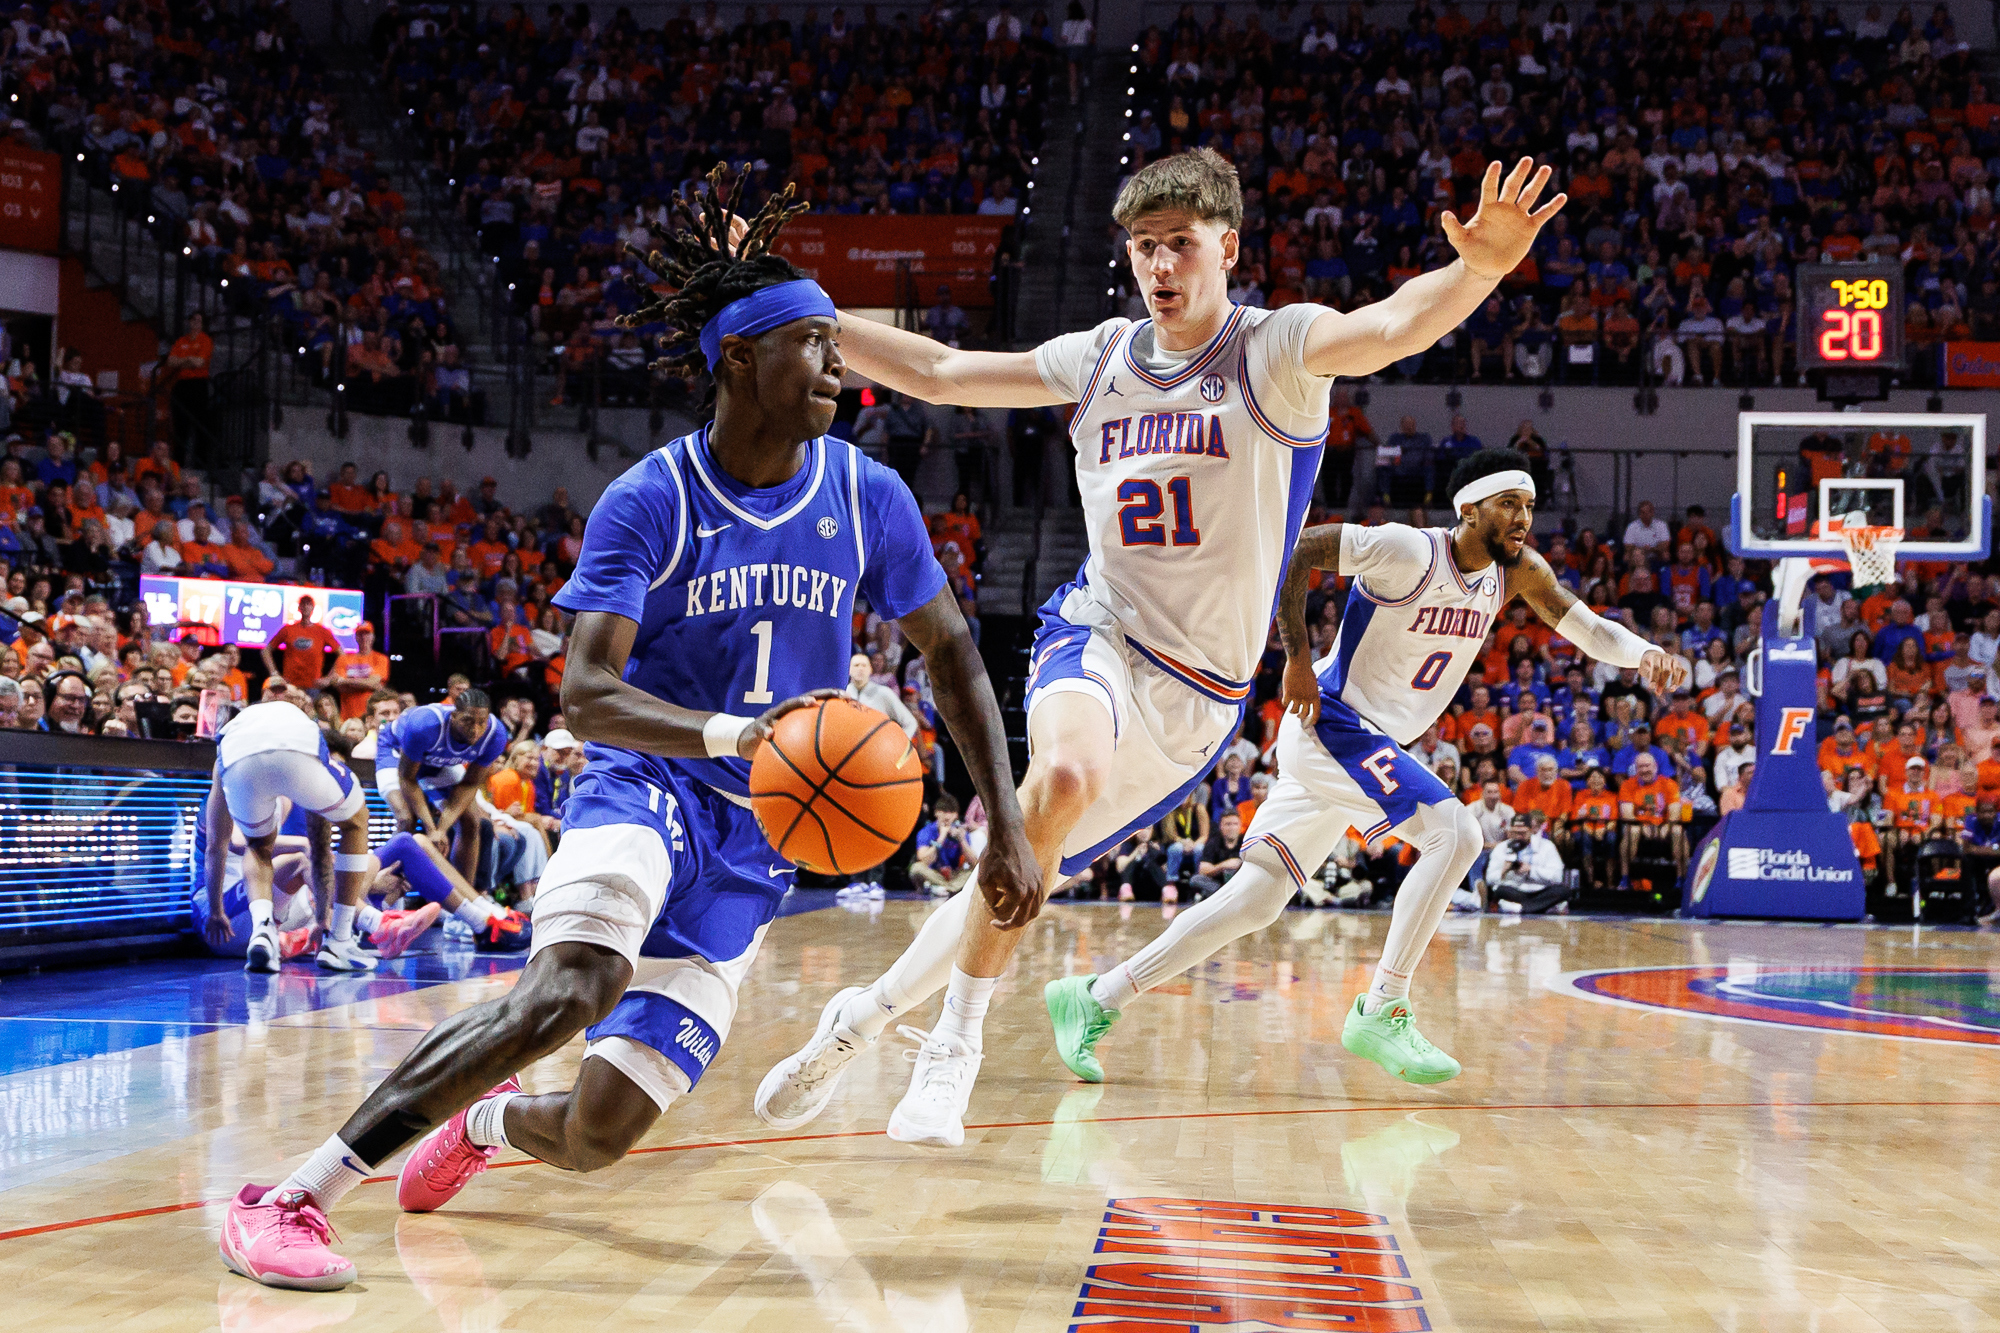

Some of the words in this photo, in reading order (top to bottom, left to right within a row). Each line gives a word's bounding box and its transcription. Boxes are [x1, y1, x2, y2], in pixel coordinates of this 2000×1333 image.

[1831, 279, 1888, 310] 7:50
[1820, 310, 1882, 361] 20
[1201, 374, 1224, 401] SEC
[1099, 412, 1230, 465] FLORIDA
[818, 517, 838, 539] SEC
[1117, 476, 1201, 547] 21
[185, 595, 220, 624] 17
[686, 563, 848, 619] KENTUCKY
[743, 620, 774, 705] 1
[1411, 651, 1453, 691] 0
[1770, 707, 1814, 756] F
[1360, 747, 1400, 796] F
[1760, 848, 1810, 867] Florida
[1760, 864, 1805, 881] Credit
[1807, 866, 1853, 882] Union
